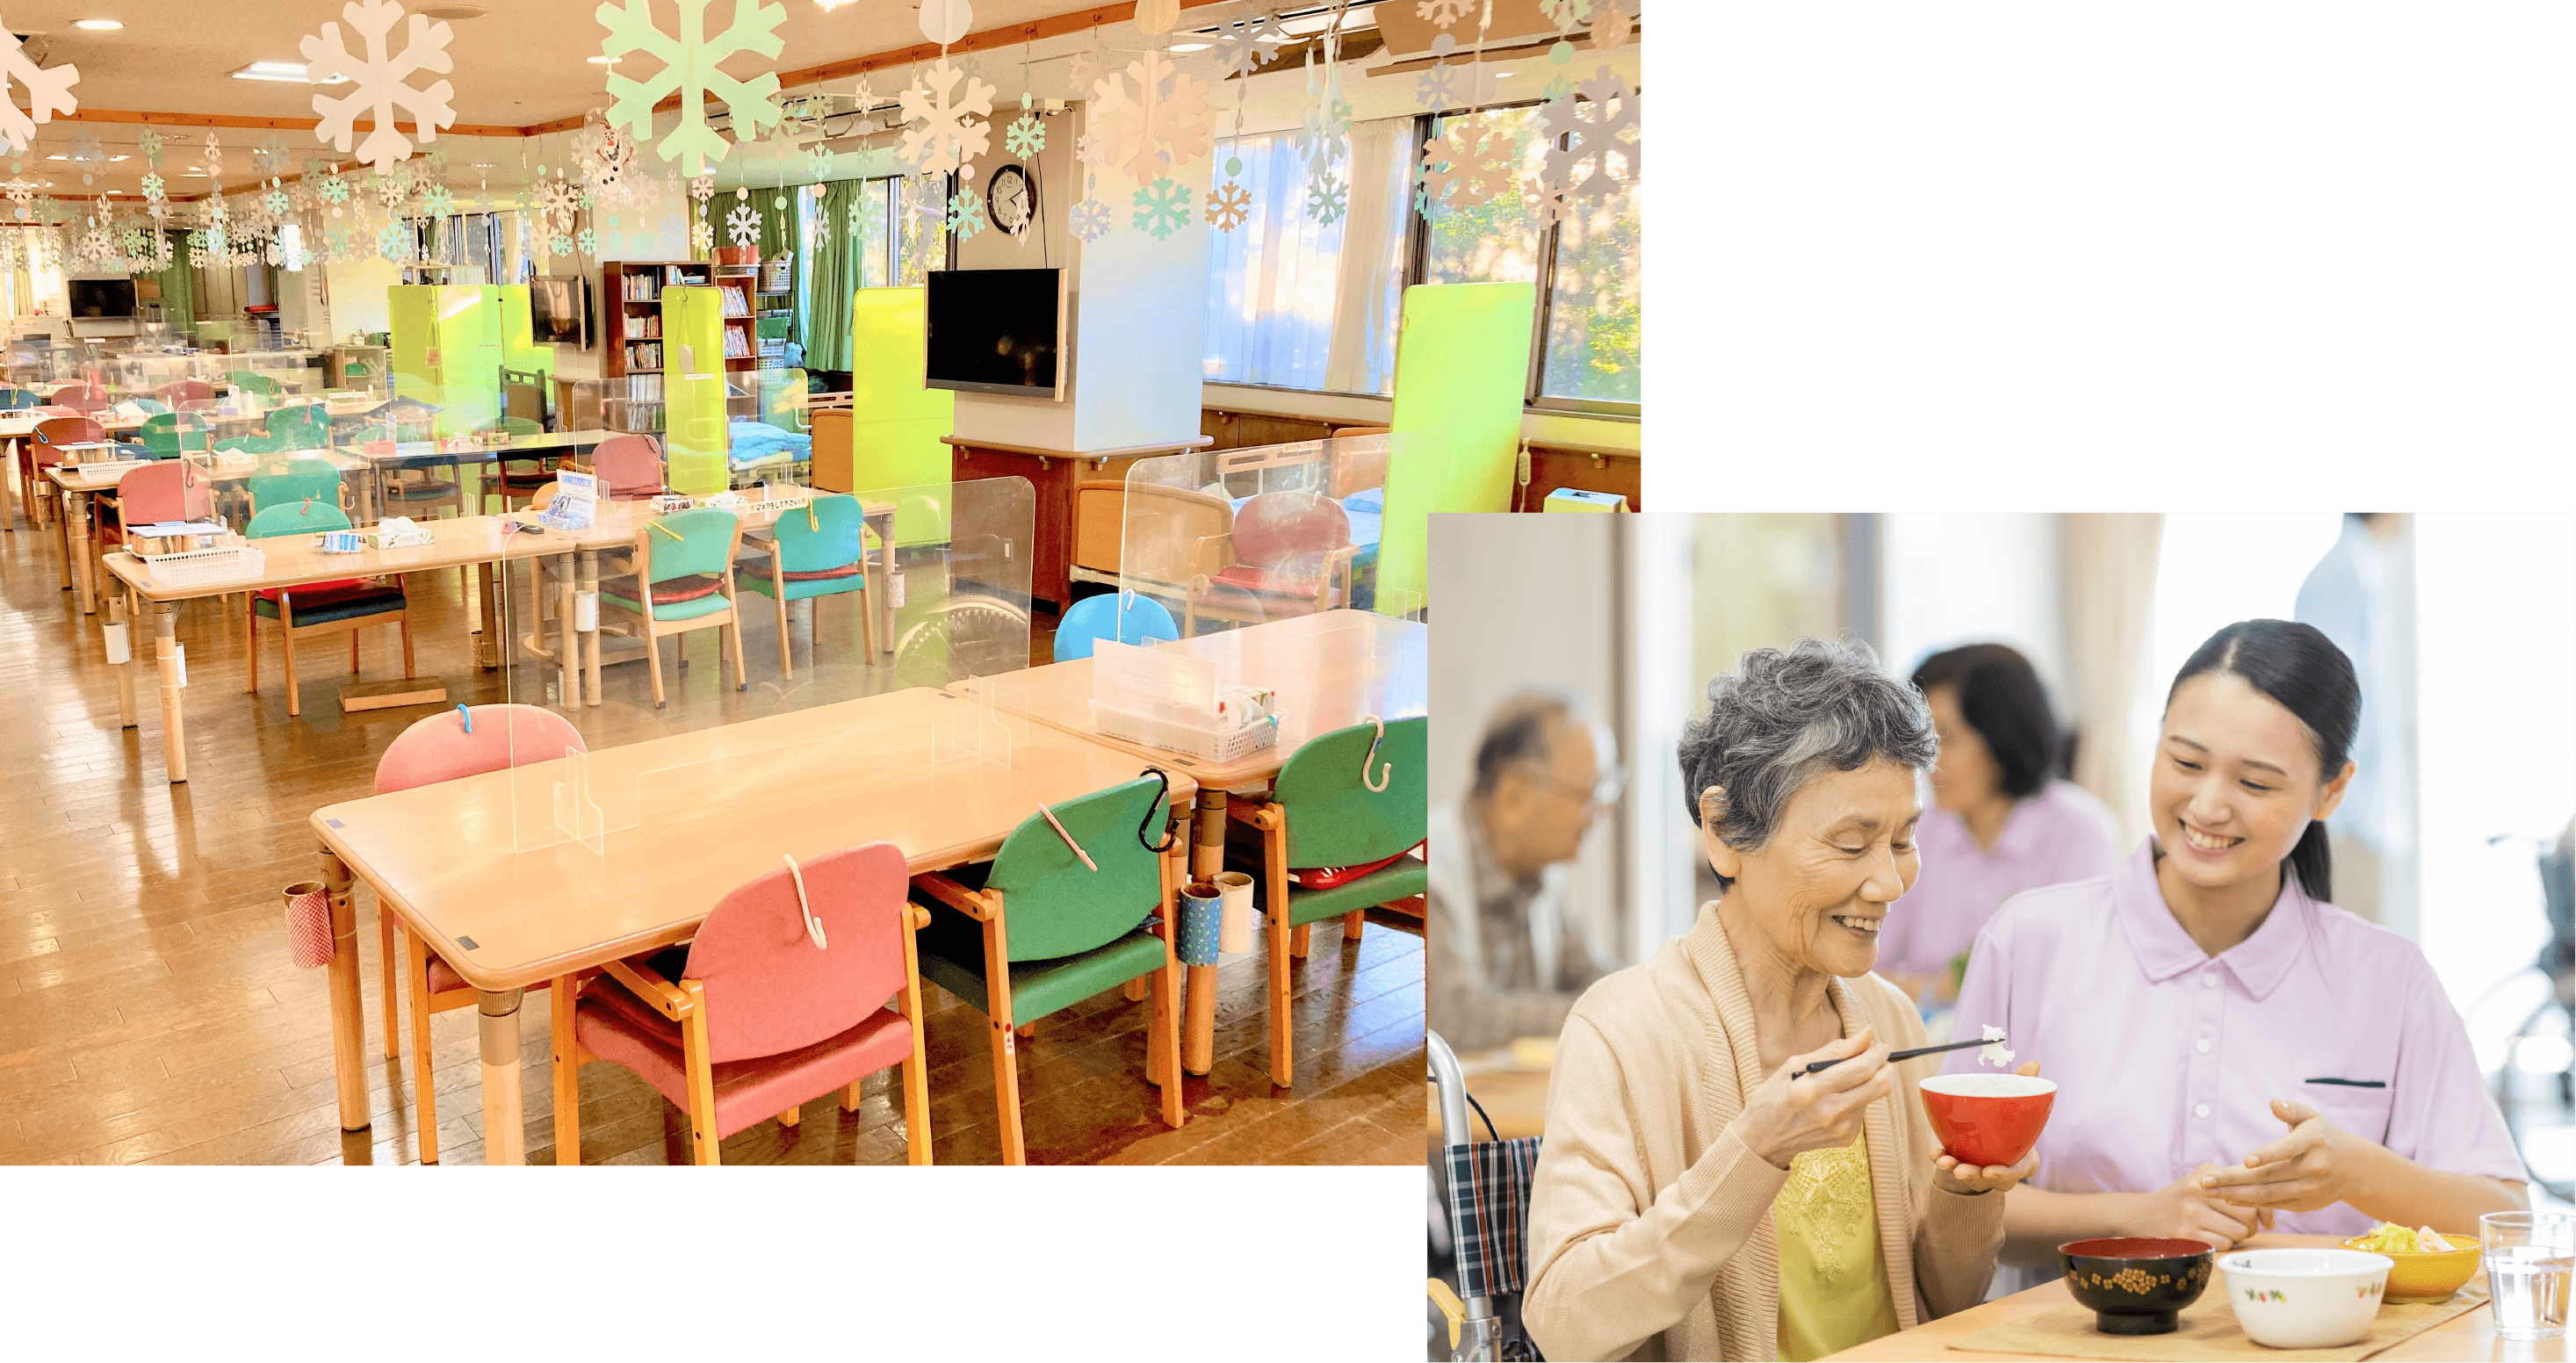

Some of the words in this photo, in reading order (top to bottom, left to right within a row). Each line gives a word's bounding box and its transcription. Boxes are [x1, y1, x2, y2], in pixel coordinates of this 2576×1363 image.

[1001, 178, 1006, 187] 11
[755, 499, 801, 511] マスクをして下さい
